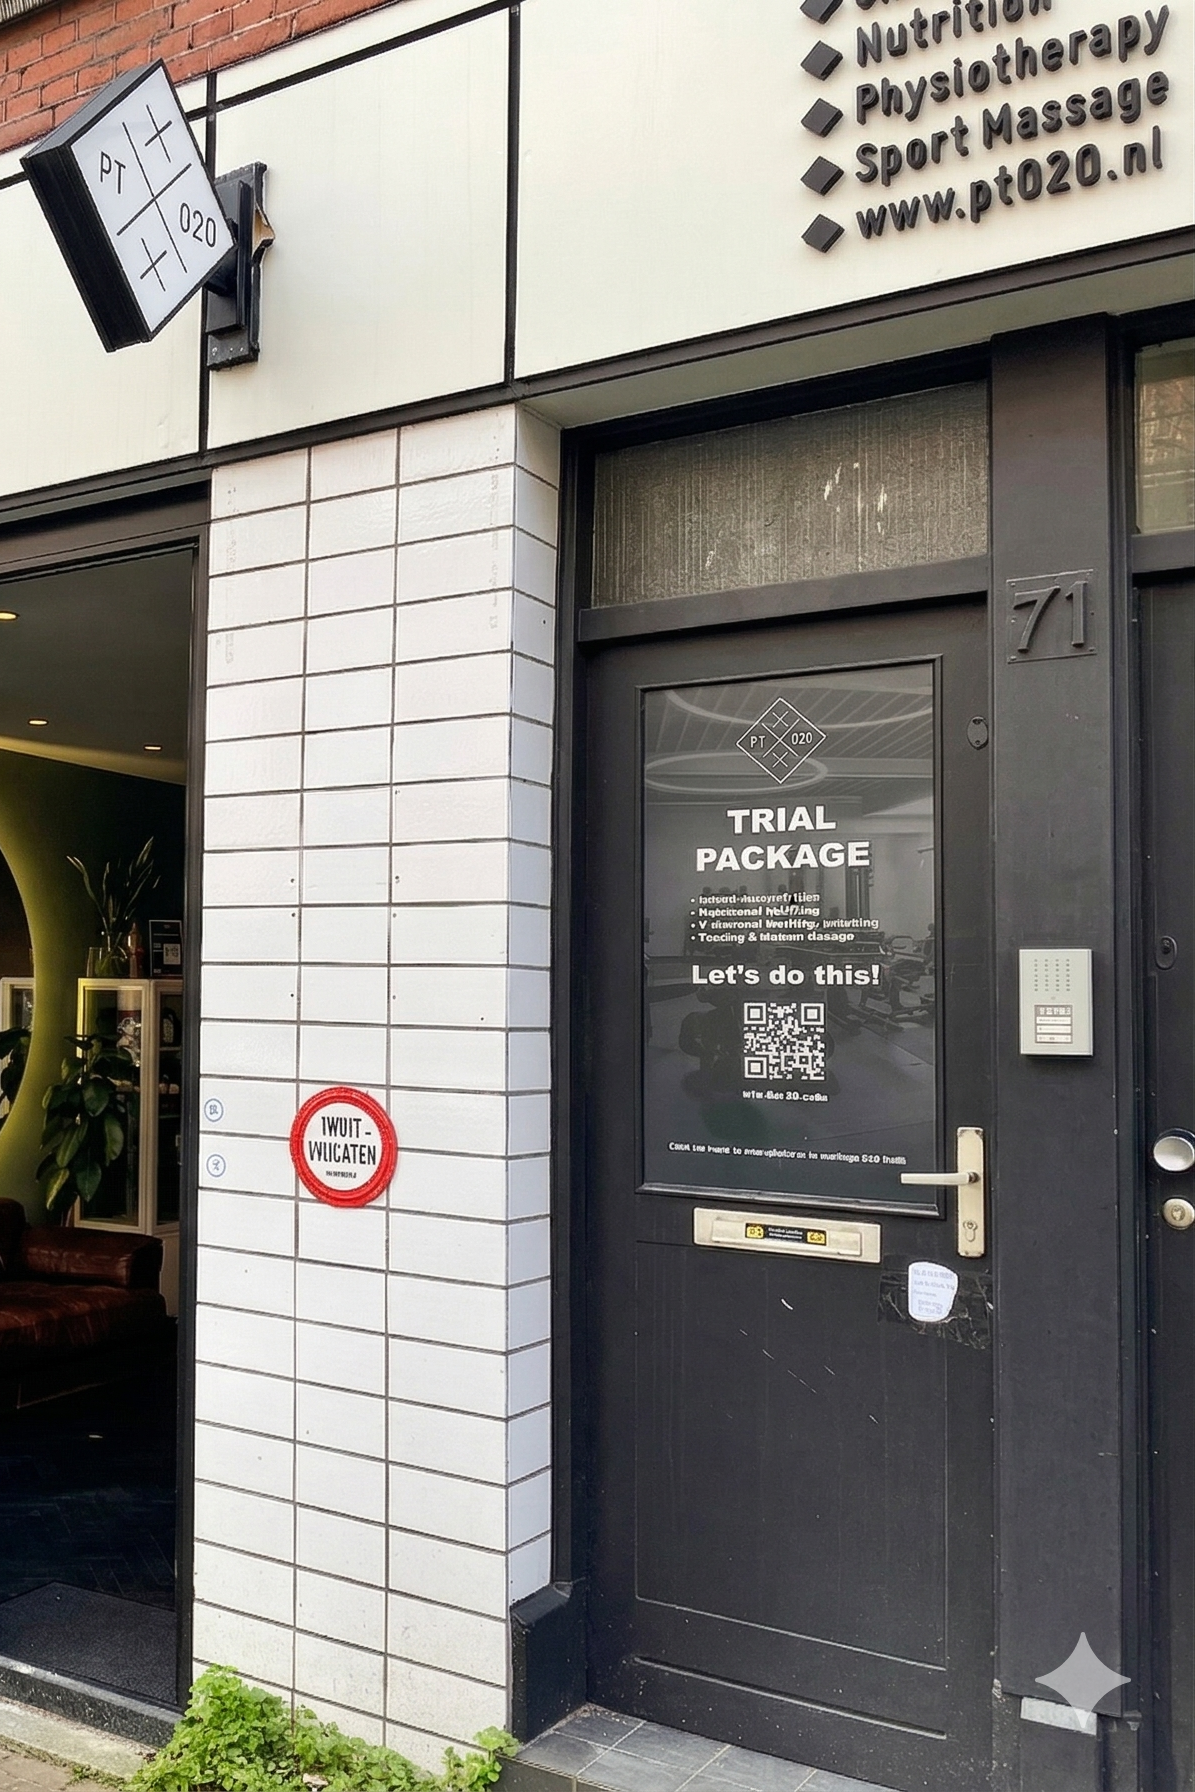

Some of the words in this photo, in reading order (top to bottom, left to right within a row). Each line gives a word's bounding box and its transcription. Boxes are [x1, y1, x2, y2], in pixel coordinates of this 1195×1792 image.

[856, 5, 1169, 125] Physiotherapy
[855, 115, 969, 187] Sport
[982, 71, 1169, 150] Massage
[100, 151, 126, 194] PT
[179, 202, 216, 248] 020
[856, 125, 1163, 240] www.pt020.nl
[1013, 581, 1089, 653] 71
[750, 735, 766, 748] PT
[791, 732, 813, 745] 020
[727, 805, 836, 834] TRIAL
[696, 841, 870, 871] PACKAGE
[692, 964, 760, 985] Let's
[769, 964, 805, 985] do
[814, 964, 880, 985] this!
